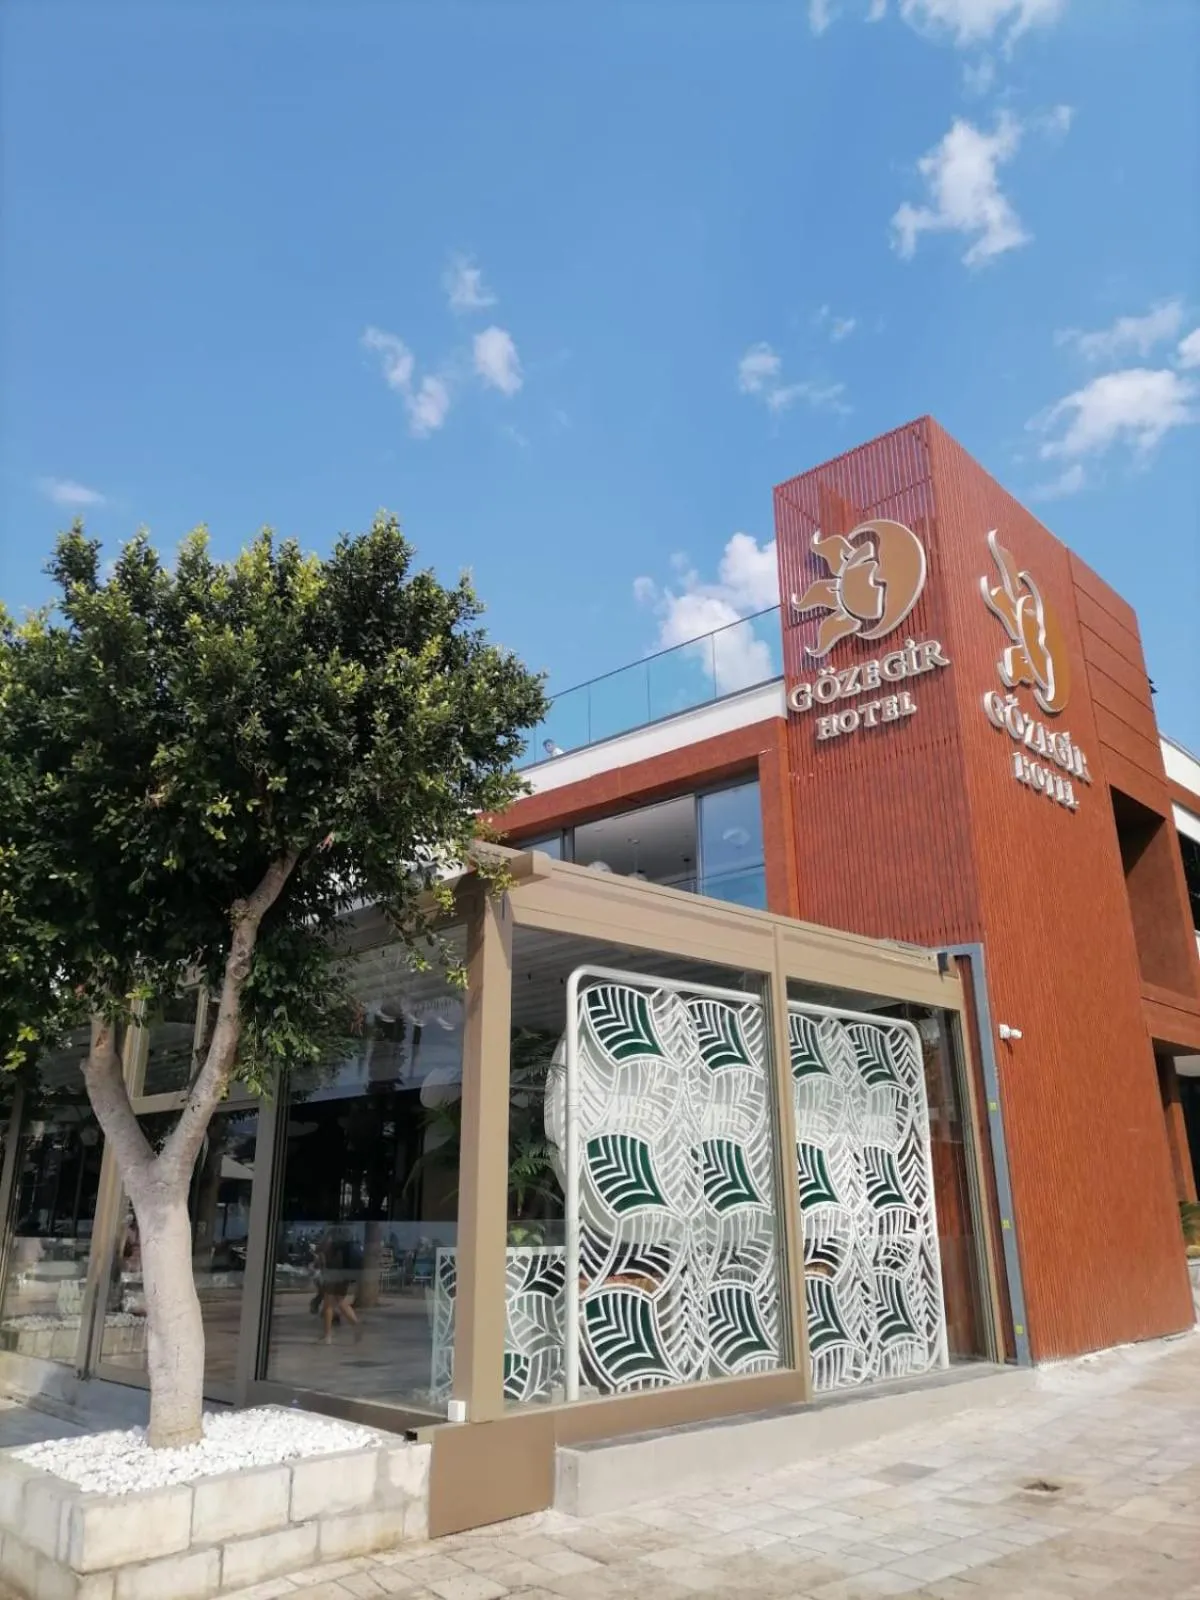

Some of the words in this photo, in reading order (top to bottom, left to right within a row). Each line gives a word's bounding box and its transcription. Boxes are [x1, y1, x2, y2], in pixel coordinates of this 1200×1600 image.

[789, 638, 949, 710] GÖZEGİR
[816, 692, 917, 740] HOTEL
[1013, 752, 1079, 809] HOTEL
